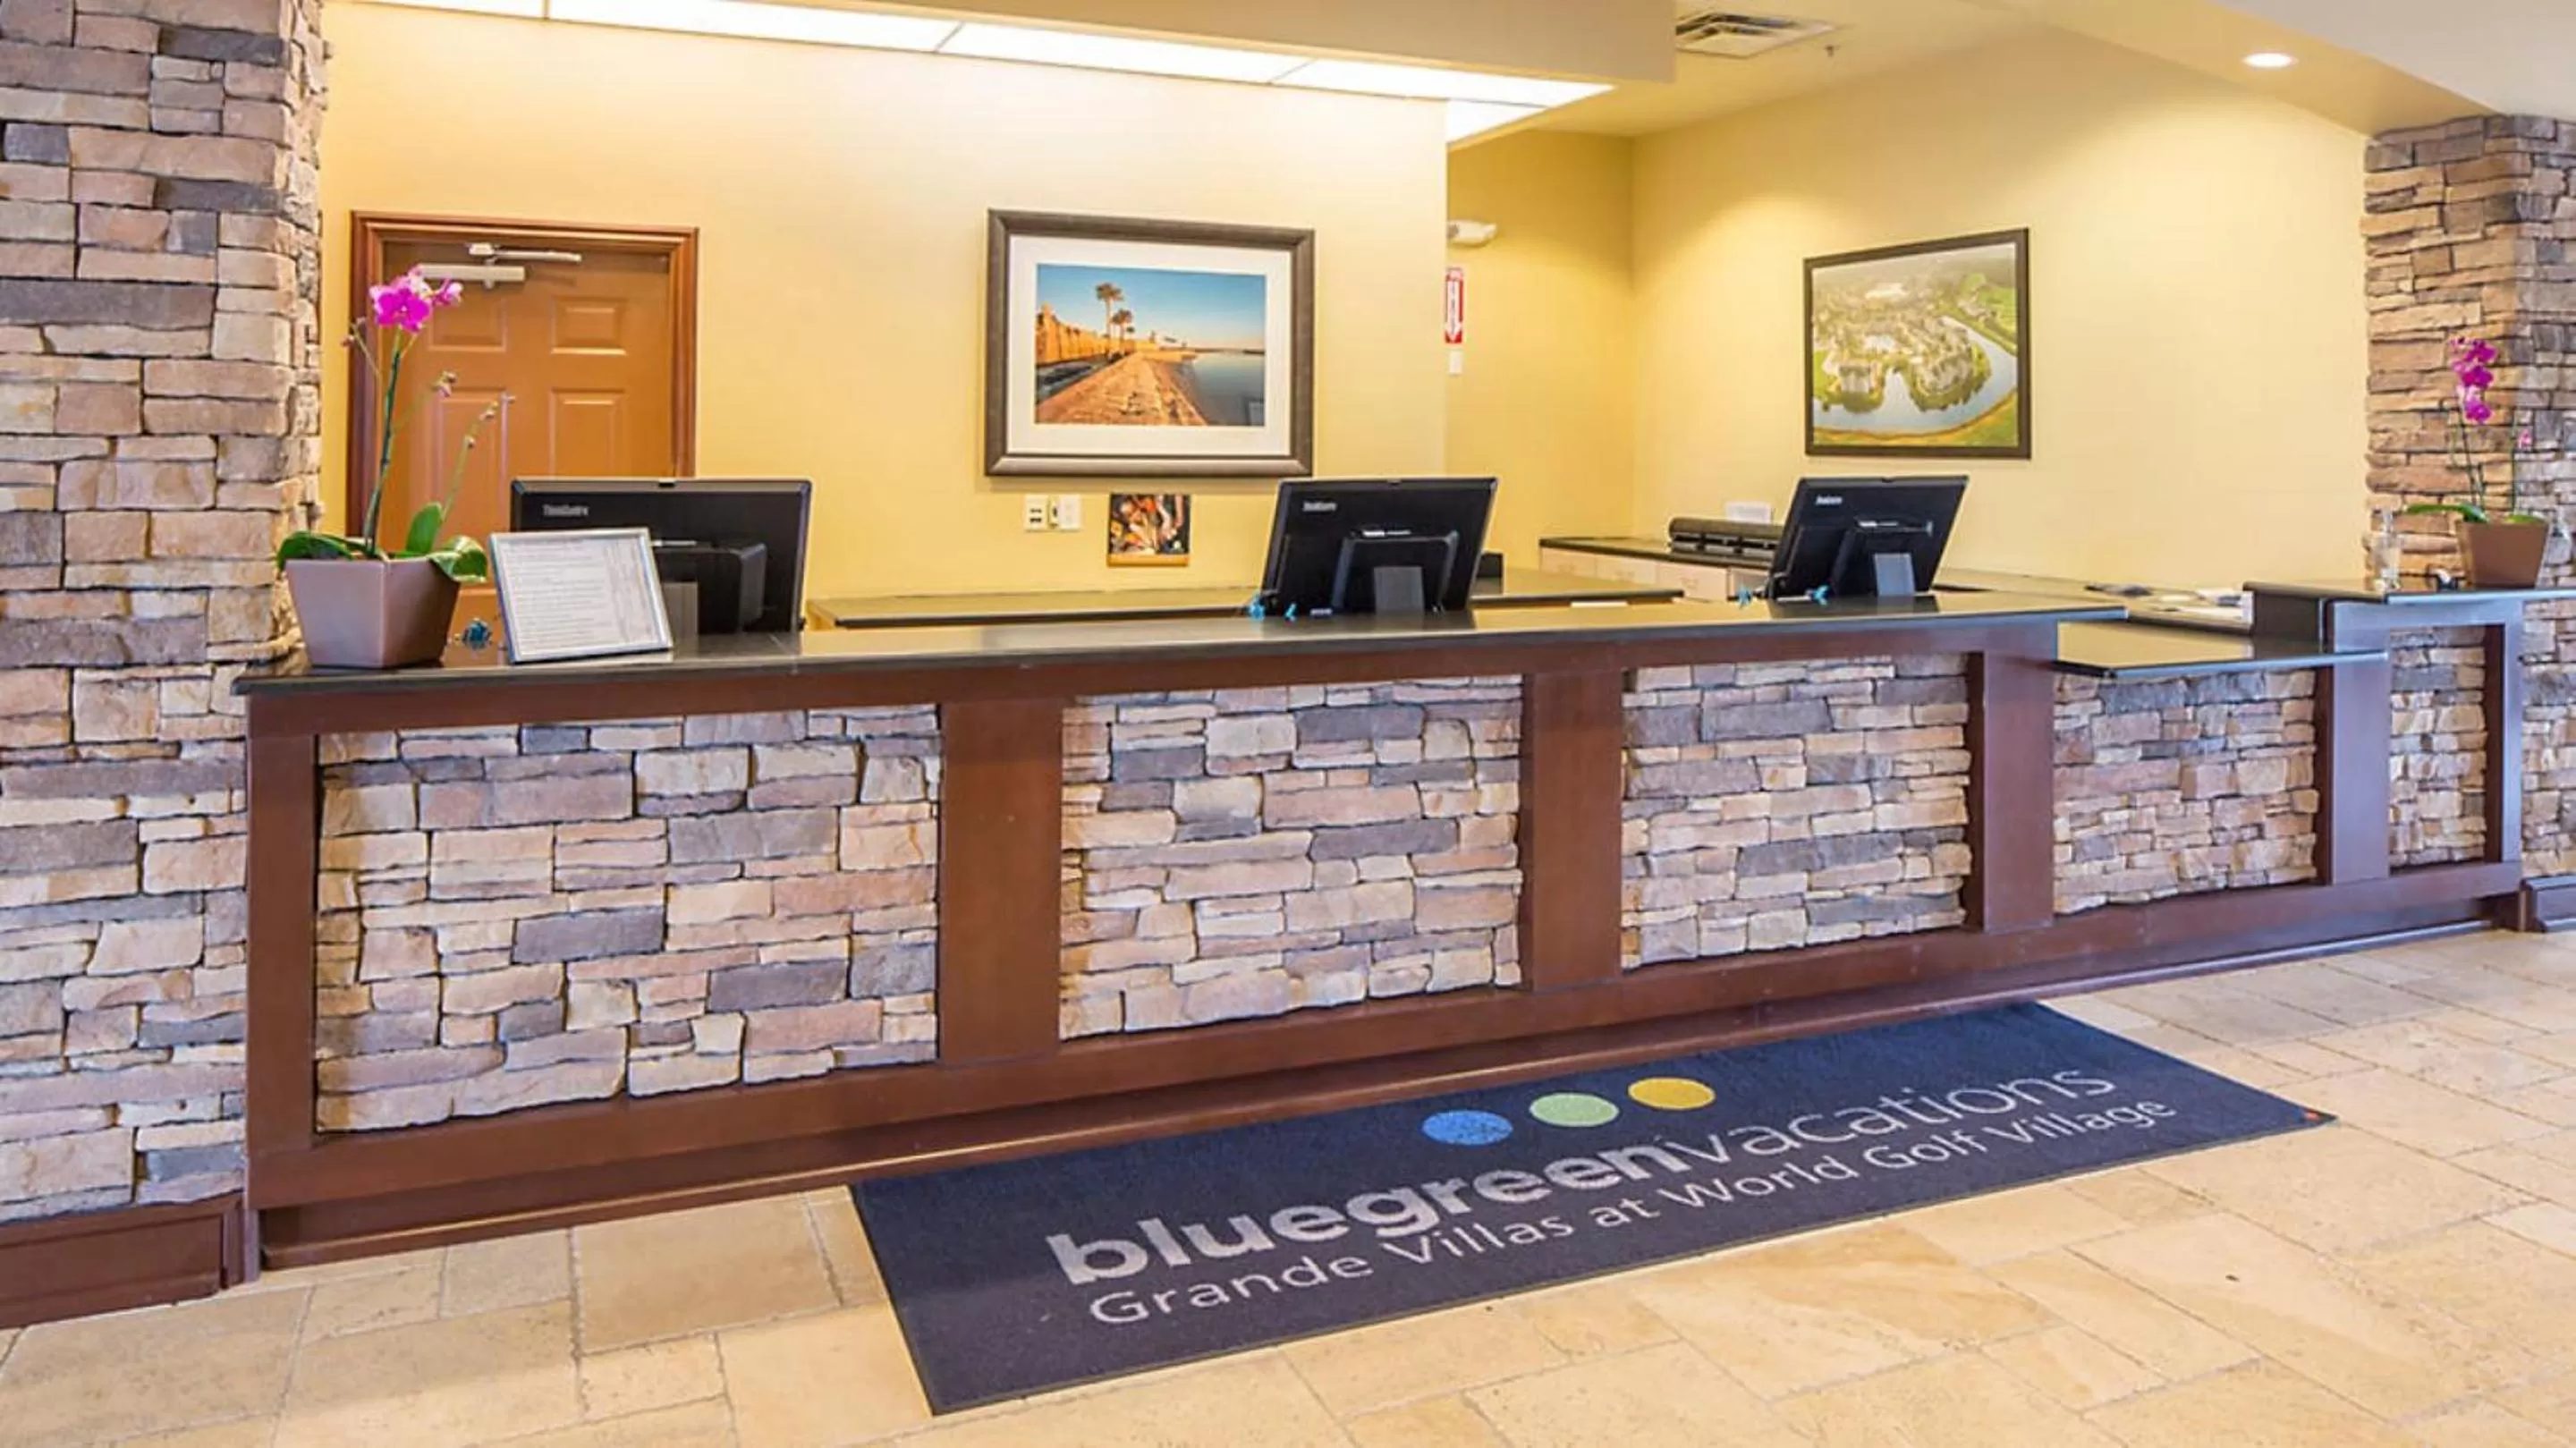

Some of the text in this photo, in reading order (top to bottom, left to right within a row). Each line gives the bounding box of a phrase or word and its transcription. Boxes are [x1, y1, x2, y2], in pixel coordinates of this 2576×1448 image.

[1089, 1097, 2177, 1325] Grande Villas at World Golf Village
